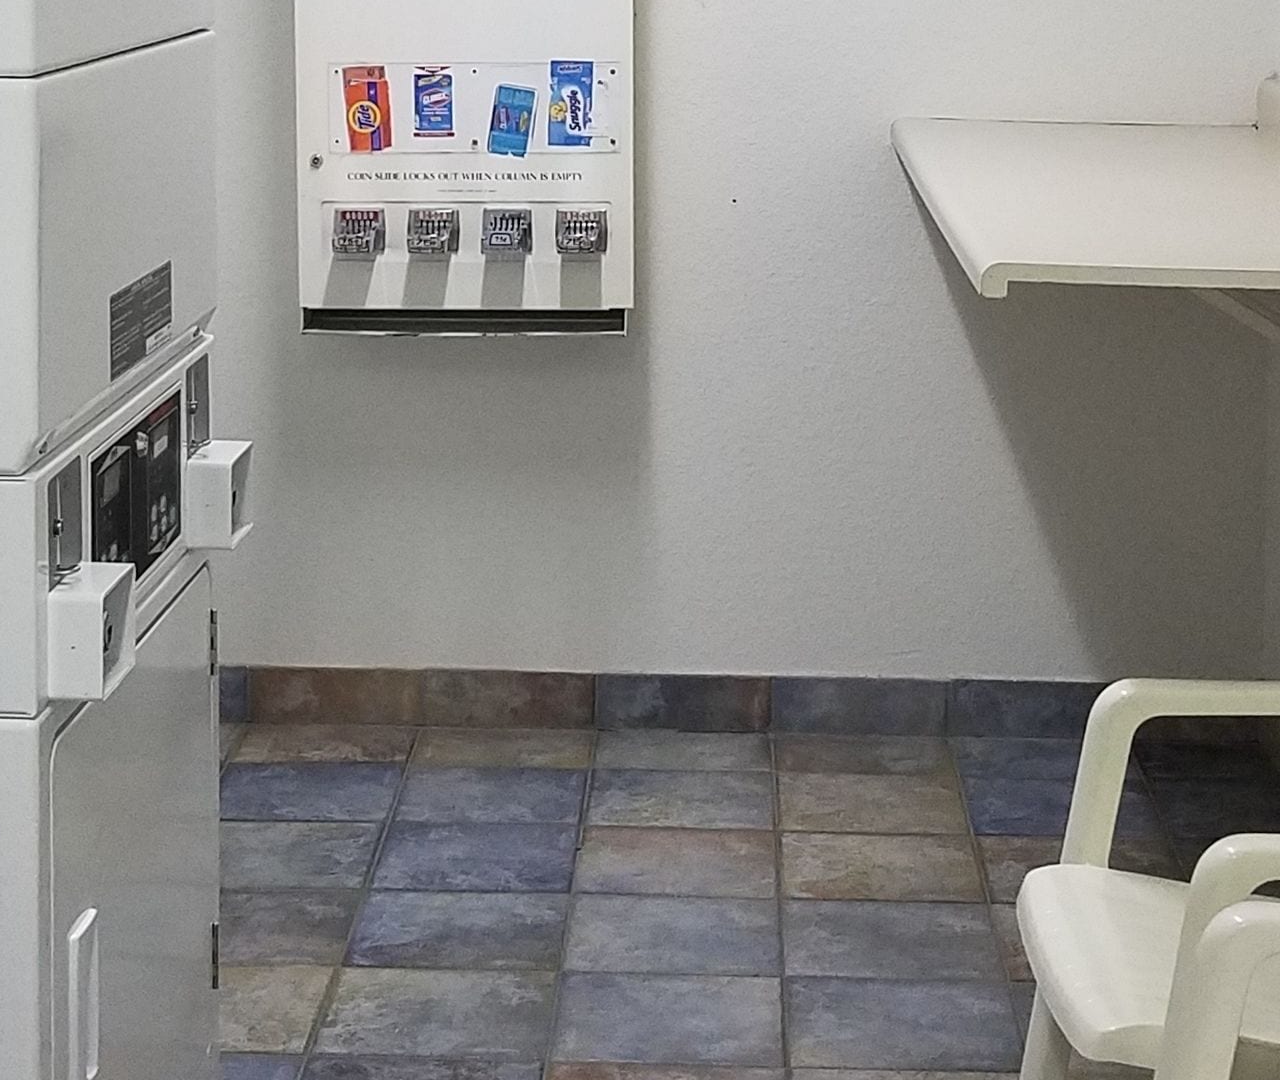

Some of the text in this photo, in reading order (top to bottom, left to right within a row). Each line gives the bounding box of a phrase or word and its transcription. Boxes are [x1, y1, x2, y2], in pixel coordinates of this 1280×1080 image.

[356, 104, 376, 129] Tide
[566, 89, 582, 132] Snuggle
[347, 171, 372, 181] COIN
[437, 171, 458, 181] OUT
[461, 171, 492, 181] WHEN
